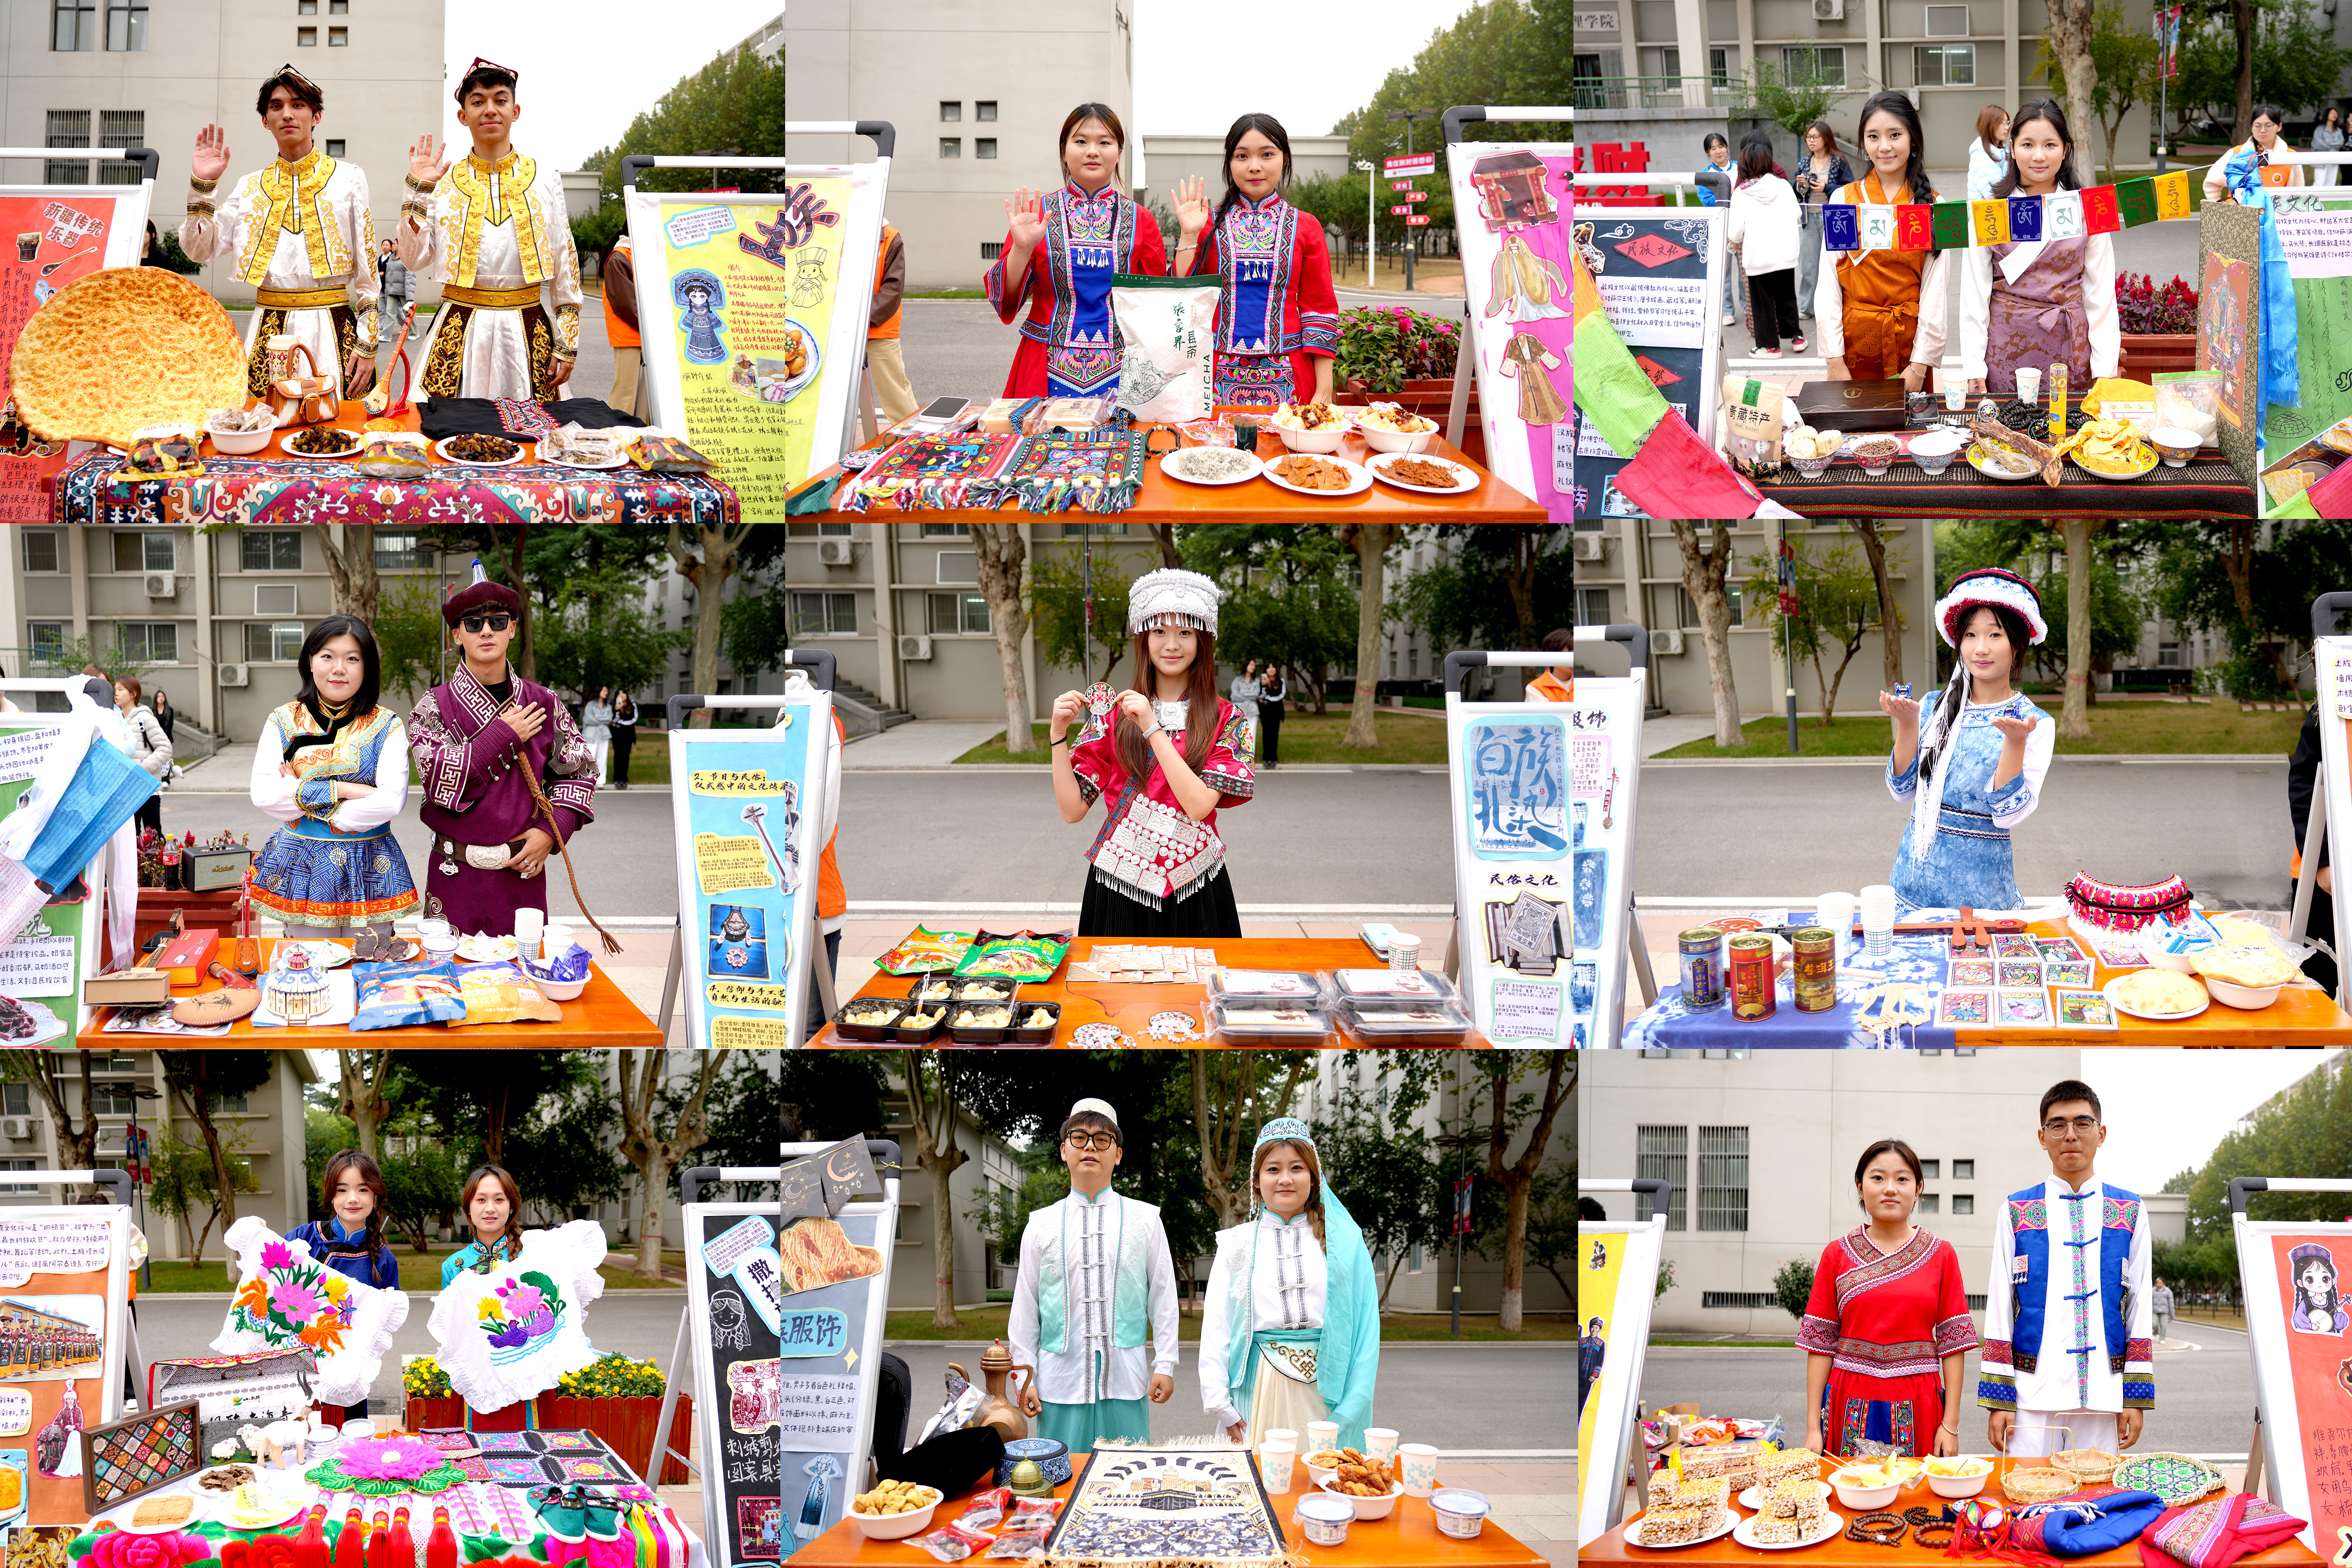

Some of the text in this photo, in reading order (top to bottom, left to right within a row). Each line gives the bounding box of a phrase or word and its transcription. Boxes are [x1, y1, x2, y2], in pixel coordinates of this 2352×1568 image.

[45, 202, 104, 237] 新疆传统
[48, 226, 79, 247] 乐器
[1628, 241, 1678, 259] 民族文化
[1600, 284, 1701, 293] 藏族文化以藏传佛教为核心，涵盖史诗
[1600, 295, 1701, 304] 《格萨尔王传》、唐卡绘画、藏戏等。酥油
[2340, 280, 2352, 321] 我的朋友
[1173, 302, 1185, 351] 張家界
[683, 372, 715, 381] 服饰介绍：
[701, 386, 728, 394] 土家族服
[1745, 385, 1753, 403] 特色
[1750, 385, 1760, 405] 高原
[1729, 404, 1770, 427] 青藏特产
[1557, 429, 1573, 438] 汉族
[1557, 445, 1572, 454] 裙等
[1557, 460, 1573, 470] 麻丝
[7, 471, 37, 481] 巴旦木纹
[1557, 477, 1573, 486] 礼仪
[710, 772, 766, 781] 节日与民俗：
[1490, 874, 1558, 886] 民俗文化
[981, 941, 1055, 955] 麻辣酸菜鱼
[1804, 958, 1835, 975] 普洱王
[726, 986, 785, 996] 信仰与手工艺
[712, 994, 785, 1006] 自然与生活的融
[715, 1032, 785, 1041] 祭祀活动多由“苗老司”（祭司）
[837, 1161, 858, 1174] Mubarak
[0, 1235, 110, 1244] 最长的狂欢节”，秋后举行，持续两月，
[781, 1381, 857, 1391] 雅，男子多着白色礼拜帽、
